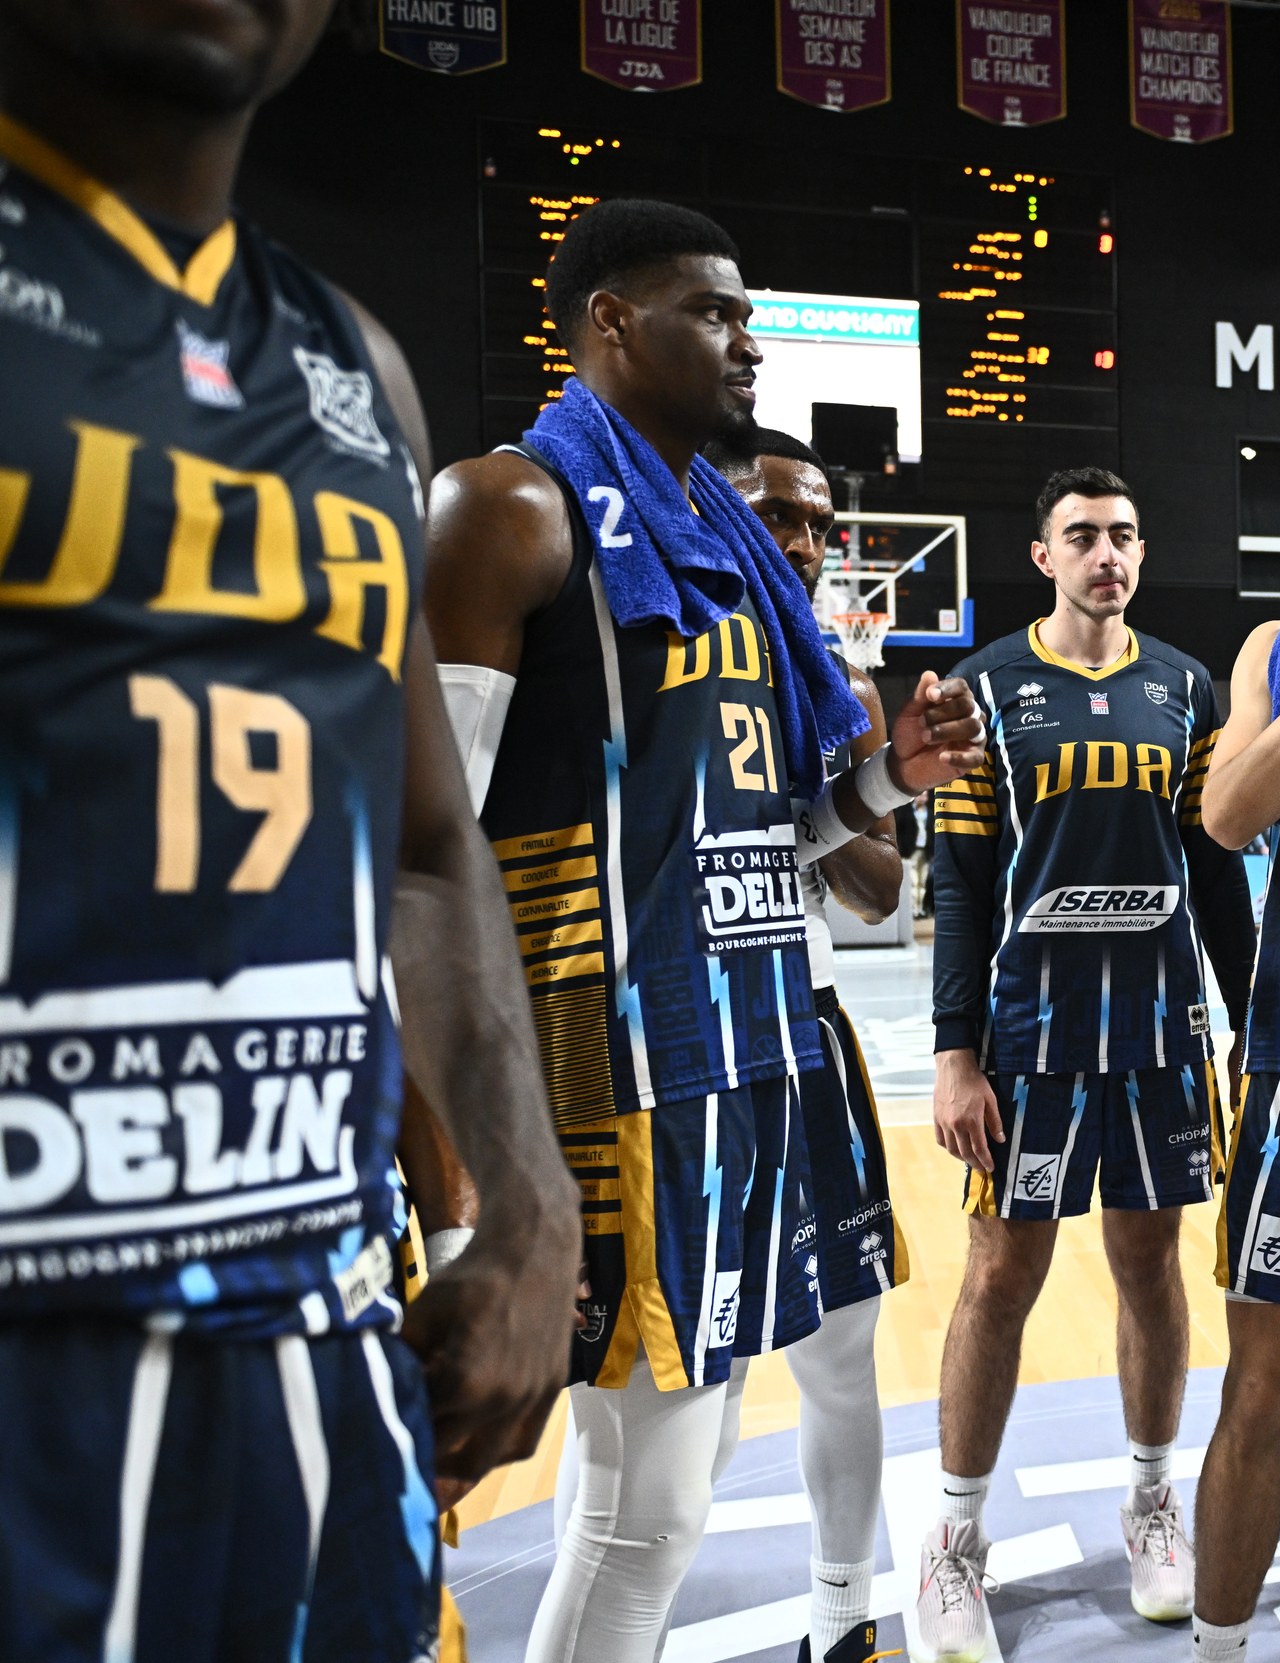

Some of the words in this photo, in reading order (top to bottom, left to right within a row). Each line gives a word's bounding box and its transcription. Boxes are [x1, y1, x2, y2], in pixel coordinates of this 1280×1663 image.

[659, 0, 681, 24] DE
[968, 7, 1053, 37] VAINQUEUR
[606, 19, 628, 45] LA
[631, 23, 678, 50] LIGUE
[799, 15, 867, 43] SEMAINE
[1140, 27, 1219, 55] VAINQUEUR
[804, 41, 835, 67] DES
[840, 45, 863, 69] AS
[986, 34, 1035, 61] COUPE
[618, 60, 664, 80] JDA
[970, 57, 990, 82] DE
[993, 60, 1053, 88] FRANCE
[1140, 53, 1190, 76] MATCH
[1193, 56, 1220, 80] DES
[1139, 76, 1223, 104] CHAMPIONS
[587, 485, 633, 549] 2
[0, 418, 410, 685] JDA
[1019, 696, 1047, 708] errea
[1027, 713, 1044, 723] AS
[719, 702, 779, 795] 21
[127, 673, 314, 894] 19
[1033, 740, 1172, 805] JDA
[521, 837, 556, 851] FAMILLE
[1048, 890, 1166, 914] ISERBA
[1039, 919, 1100, 930] Maintenance
[1101, 918, 1156, 929] immobilière
[708, 933, 808, 952] BOURGOGNE-FRANCHE-
[838, 1200, 891, 1231] CHOPARD
[860, 1248, 887, 1266] errea
